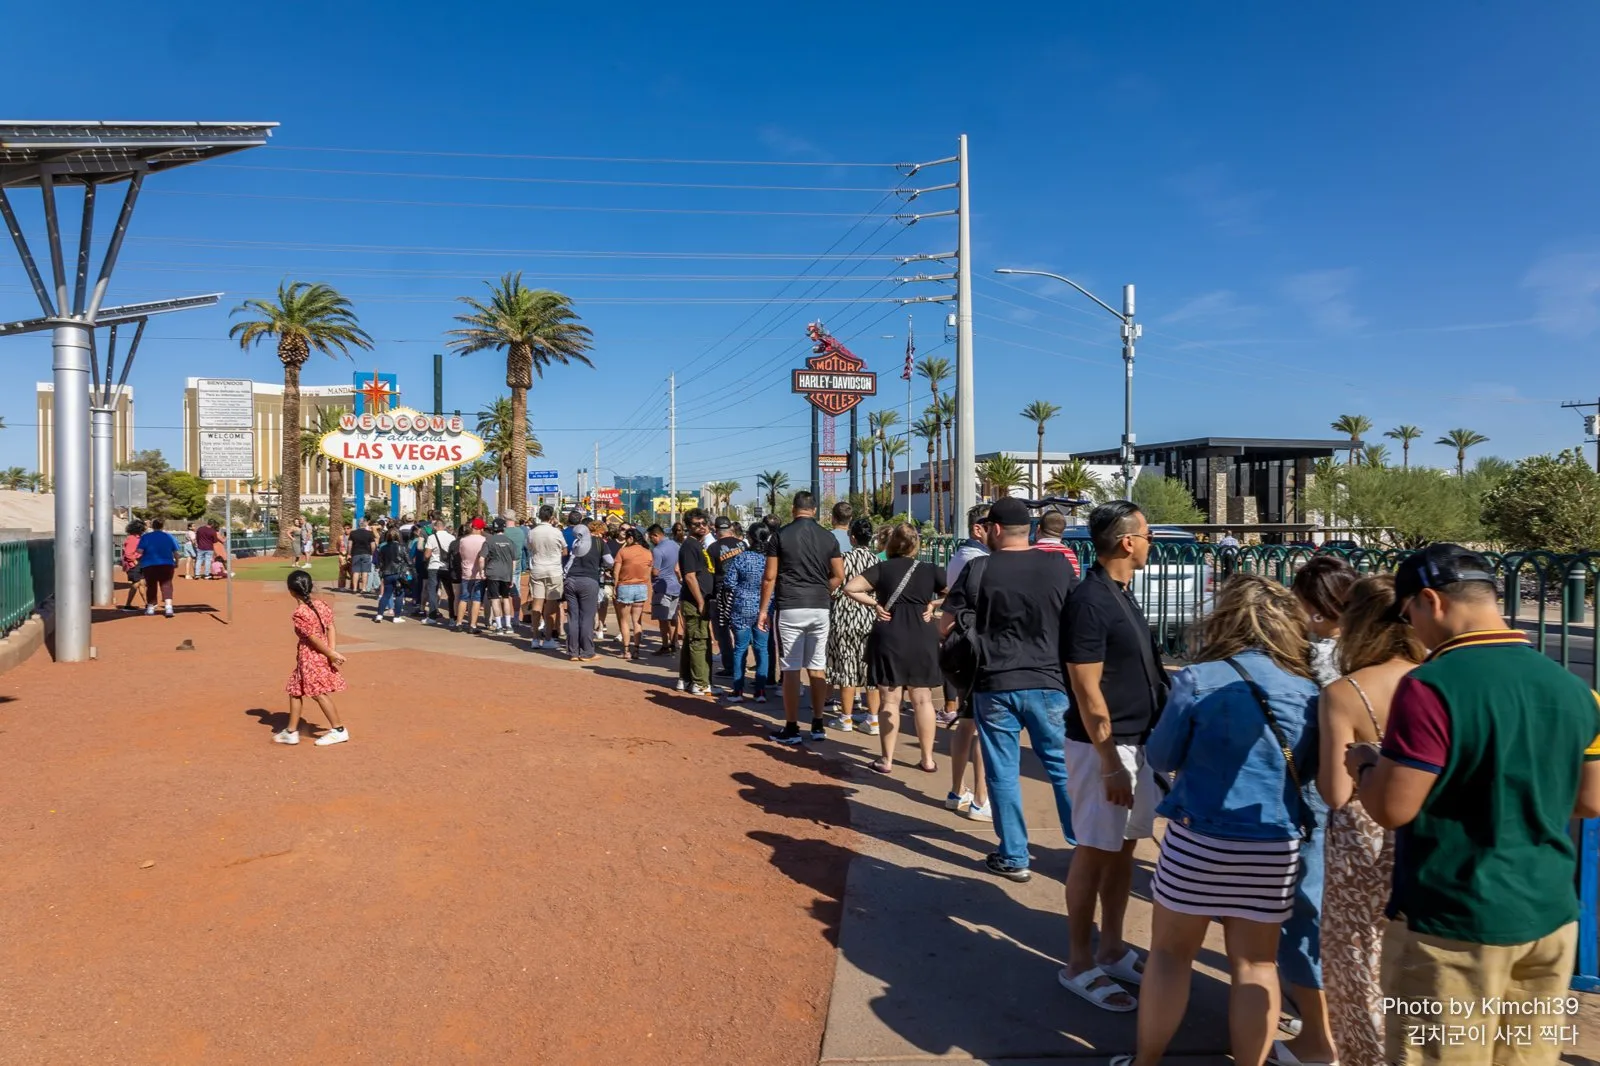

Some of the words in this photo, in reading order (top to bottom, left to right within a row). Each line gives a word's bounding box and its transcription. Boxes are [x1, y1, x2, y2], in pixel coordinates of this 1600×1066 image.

[816, 358, 855, 371] MOTOR
[799, 374, 872, 390] HARLEY-DAVIDSON
[816, 393, 855, 410] CYCLES
[342, 415, 460, 430] WELCOME
[356, 432, 368, 440] TO
[374, 431, 447, 443] Fabulous
[343, 442, 383, 459] LAS
[391, 444, 462, 461] VEGAS
